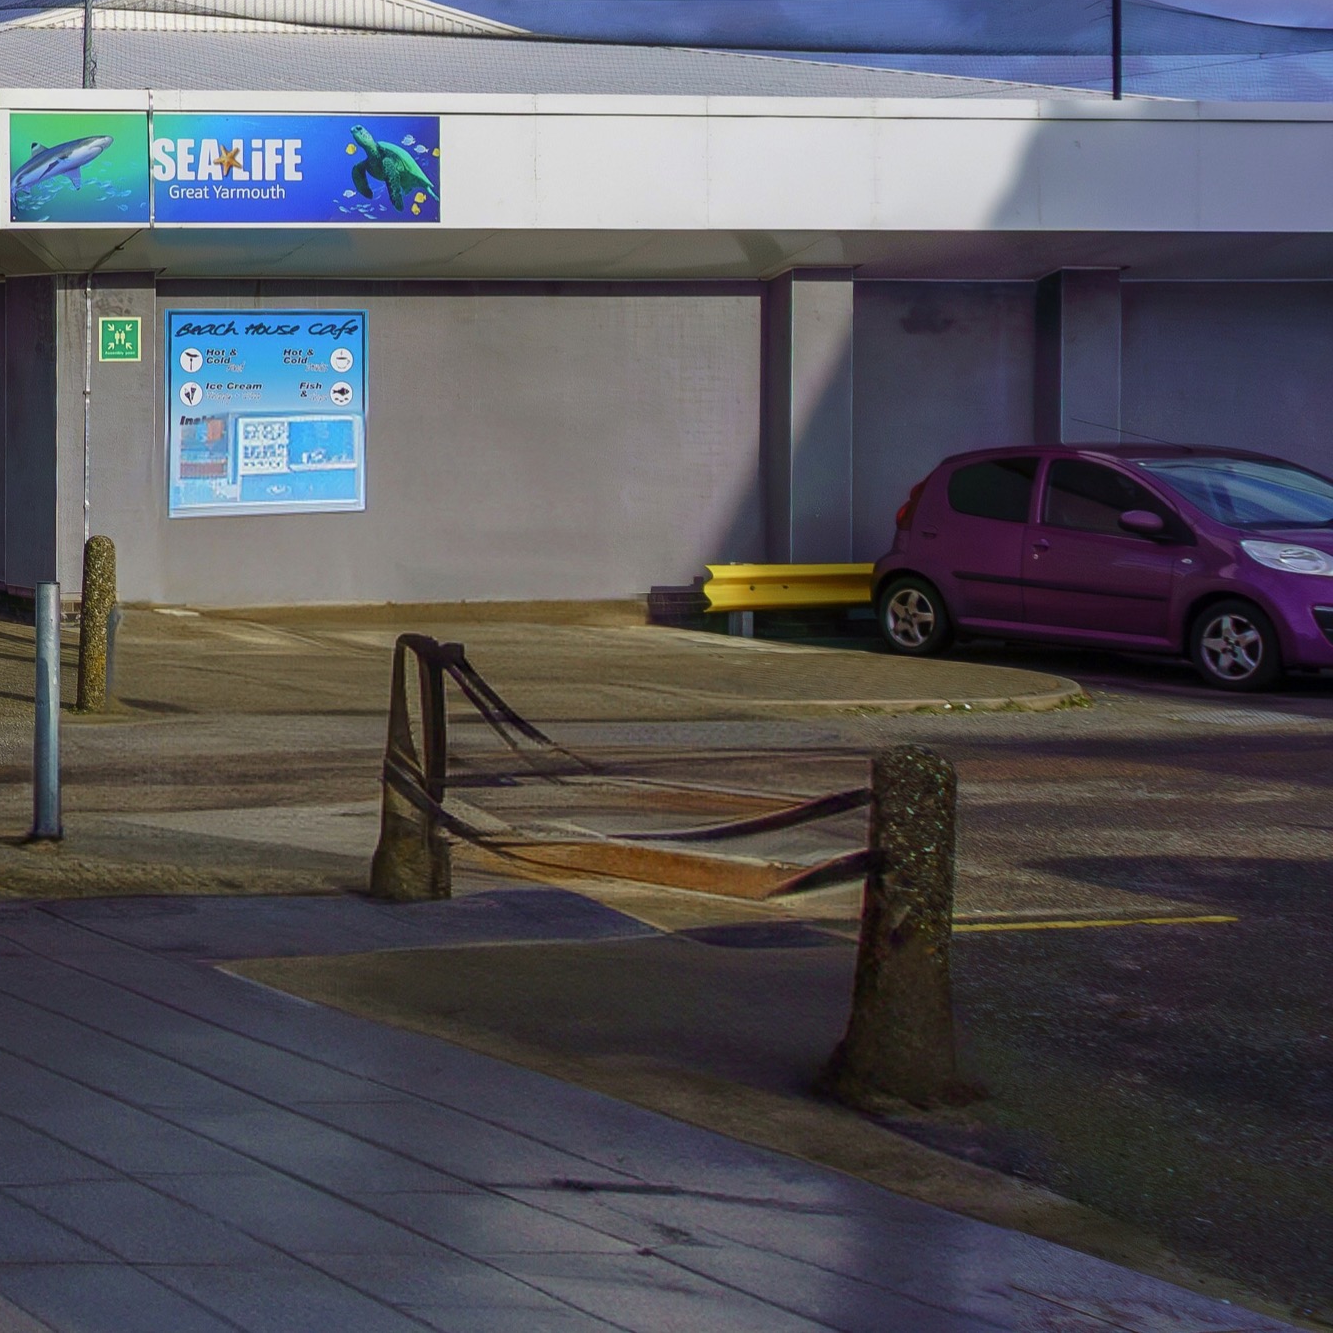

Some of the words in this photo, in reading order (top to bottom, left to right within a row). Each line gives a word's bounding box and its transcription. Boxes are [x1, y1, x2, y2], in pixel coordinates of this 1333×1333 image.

[153, 138, 223, 181] SEA
[169, 185, 209, 199] Great
[213, 184, 285, 199] Yarmouth
